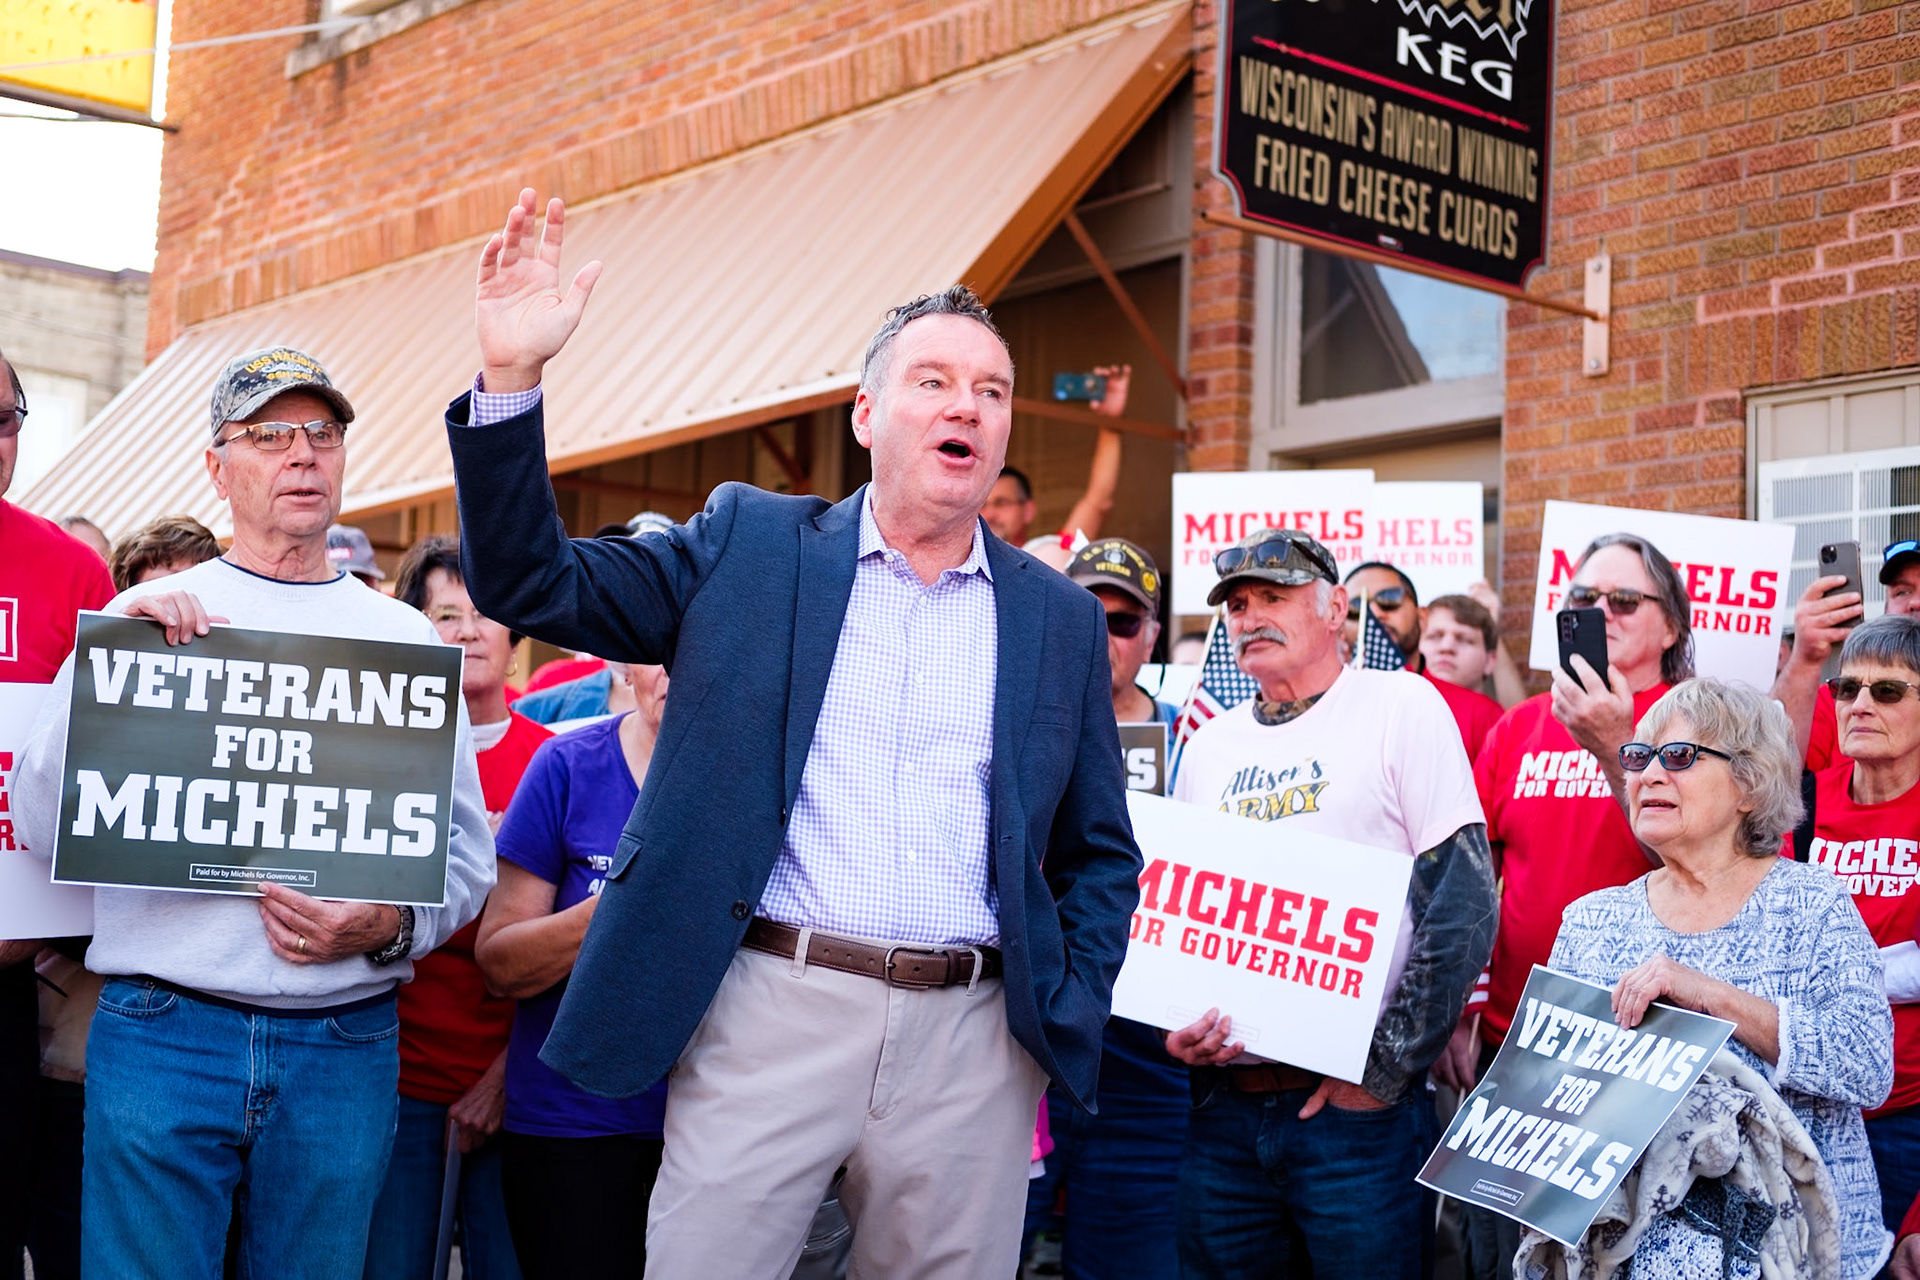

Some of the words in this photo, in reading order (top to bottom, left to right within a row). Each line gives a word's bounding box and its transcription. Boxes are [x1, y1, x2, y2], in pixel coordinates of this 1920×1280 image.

[1396, 26, 1513, 102] KEG
[1239, 55, 1377, 152] WISCONSIN'S
[1381, 101, 1453, 175] AWARD
[1457, 125, 1538, 203] WINNING
[1254, 134, 1331, 206] FRIED
[1338, 160, 1432, 236] CHEESE
[1438, 190, 1519, 260] CURDS
[245, 355, 272, 374] USS
[1103, 541, 1121, 551] AIR
[1374, 551, 1474, 566] VERNOR
[1378, 518, 1473, 547] HELS
[1095, 561, 1132, 577] VETERAN
[1548, 548, 1778, 610] MELS
[1692, 608, 1772, 636] RNOR
[88, 647, 448, 730] VETERANS
[211, 725, 314, 774] FOR
[71, 769, 438, 857] MICHELS
[1513, 780, 1549, 800] FOR
[195, 867, 210, 876] Paid
[210, 868, 221, 876] for
[221, 869, 230, 878] by
[230, 870, 255, 879] Michels
[255, 871, 266, 879] for
[1137, 858, 1379, 964] MICHELS
[1180, 926, 1364, 999] GOVERNOR
[1516, 997, 1707, 1092] VETERANS
[1541, 1073, 1602, 1116] FOR
[1446, 1095, 1634, 1201] MICHELS
